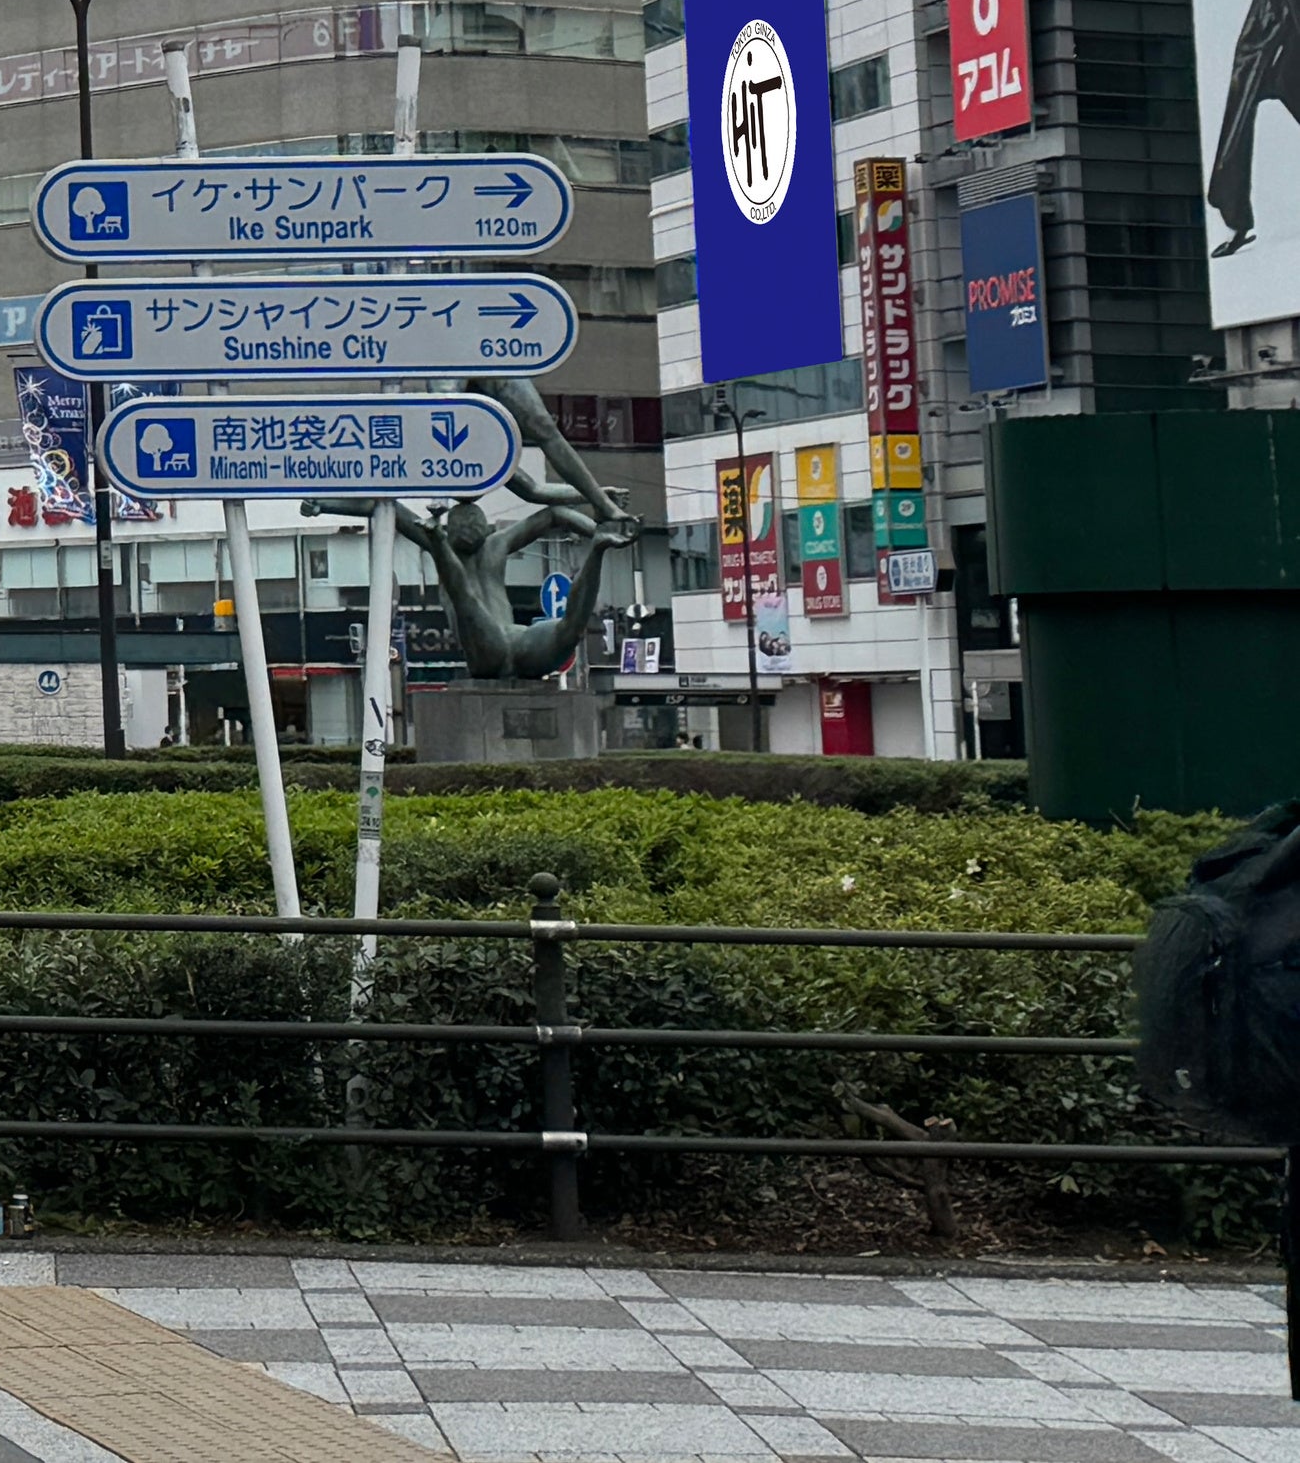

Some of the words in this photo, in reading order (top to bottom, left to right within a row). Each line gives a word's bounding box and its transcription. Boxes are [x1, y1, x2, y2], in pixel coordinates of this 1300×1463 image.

[731, 25, 753, 60] TOKYO
[754, 22, 776, 46] GINZA
[957, 47, 1022, 112] アコム
[874, 165, 901, 189] 薬
[151, 174, 451, 213] イケ・サンパーク
[229, 216, 264, 240] Ike
[275, 214, 373, 243] Sunpark
[474, 217, 537, 237] 1120m
[967, 266, 1036, 314] PROMISE
[145, 296, 461, 332] サンシャインシティ
[878, 243, 913, 411] サンドラッグ
[1009, 305, 1038, 327] プロミス
[224, 336, 332, 361] Sunshine
[343, 334, 388, 363] City
[479, 338, 542, 358] 630m
[48, 395, 82, 410] Merry
[212, 414, 404, 451] 南池袋公園
[209, 455, 363, 481] Minami-Ikebukuro
[370, 455, 408, 478] Park
[421, 459, 484, 478] 330m
[723, 573, 778, 604] サンラッグ
